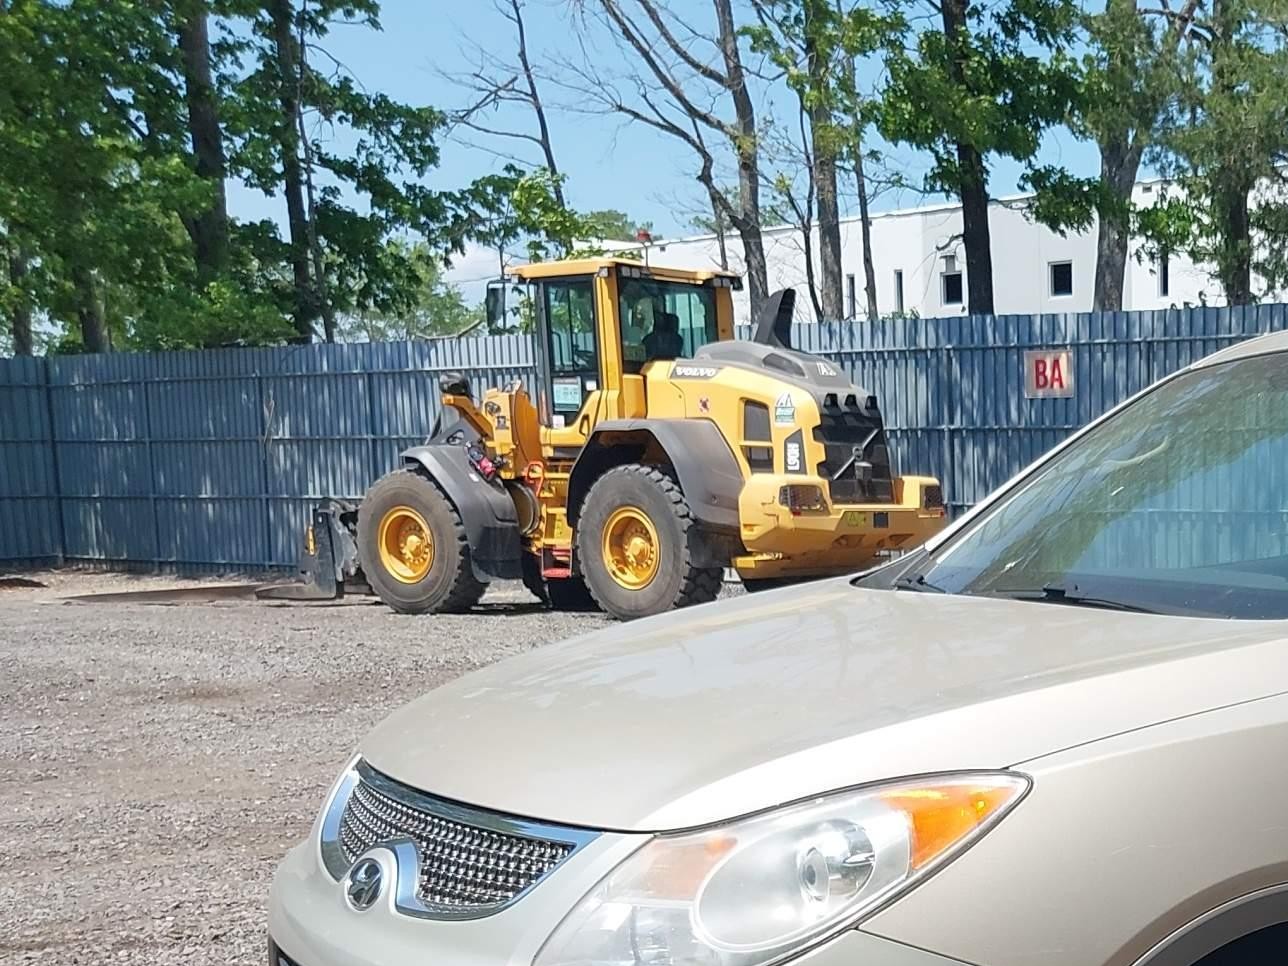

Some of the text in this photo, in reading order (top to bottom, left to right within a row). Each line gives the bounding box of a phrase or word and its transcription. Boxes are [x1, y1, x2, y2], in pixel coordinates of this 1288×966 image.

[675, 366, 716, 377] VOLVO
[1035, 359, 1064, 389] BA
[786, 442, 800, 471] L90H
